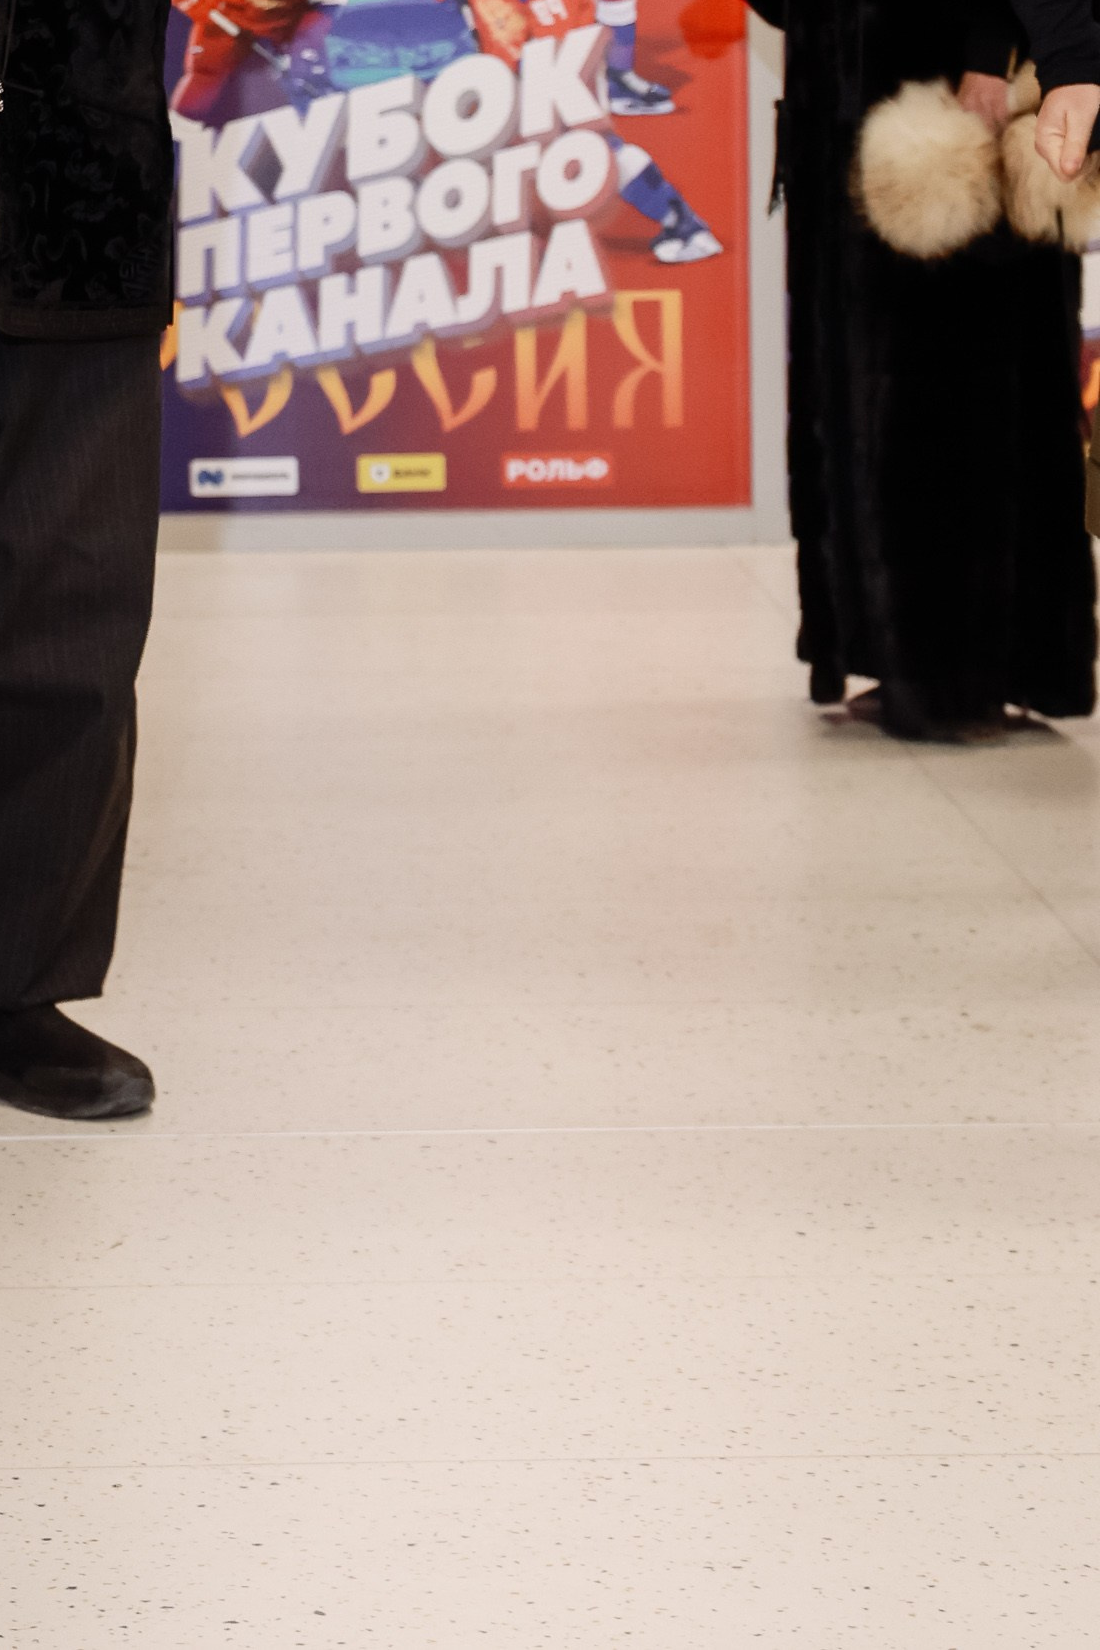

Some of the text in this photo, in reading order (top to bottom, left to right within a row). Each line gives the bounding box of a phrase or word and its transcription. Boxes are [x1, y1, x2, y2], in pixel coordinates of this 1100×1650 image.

[178, 24, 607, 223] КУБОК
[178, 129, 610, 299] ПЕРВОГО
[176, 219, 608, 383] КАНАЛА
[506, 456, 609, 483] РОЛЬФ
